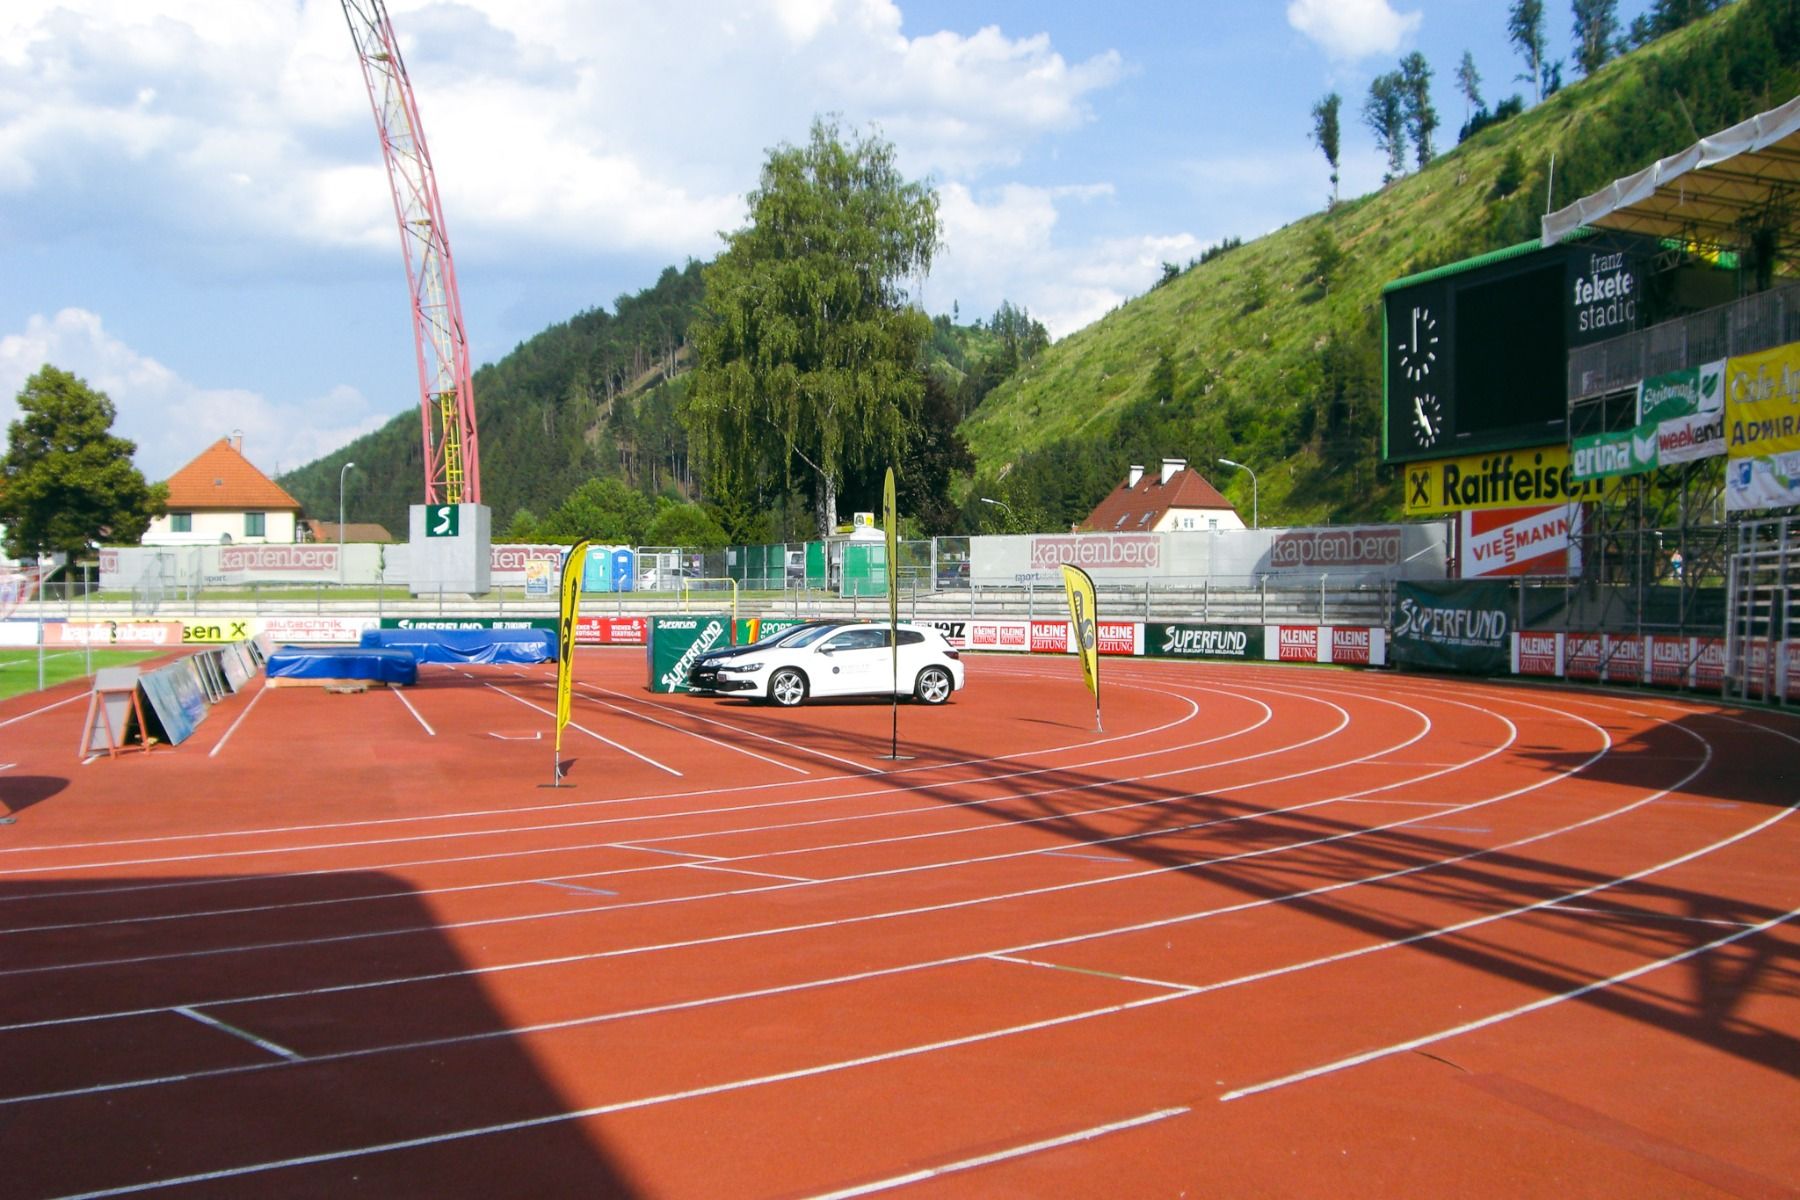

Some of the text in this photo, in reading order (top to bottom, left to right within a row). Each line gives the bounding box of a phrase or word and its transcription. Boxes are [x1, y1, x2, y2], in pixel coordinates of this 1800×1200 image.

[1591, 252, 1623, 274] franz
[1575, 270, 1634, 305] fekete
[1660, 415, 1725, 451] weekend
[1574, 439, 1631, 477] erima
[1272, 529, 1401, 567] kapfenberg
[1473, 517, 1570, 563] VIESSMANN
[219, 548, 338, 571] kapfenberg
[1032, 536, 1160, 568] kapfenberg
[266, 619, 342, 629] alutechnik
[1394, 598, 1507, 640] SUPERFUND
[974, 627, 996, 635] KLEINE
[1001, 627, 1024, 635] KLEINE
[1032, 625, 1067, 637] KLEINE
[1098, 625, 1133, 639] KLEINE
[1162, 625, 1247, 652] SUPERFUND
[1281, 630, 1316, 644] KLEINE
[1334, 631, 1369, 646] KLEINE
[1032, 639, 1067, 650] ZEITUNG
[1098, 641, 1133, 651] ZEITUNG
[1281, 646, 1317, 658] ZEITUNG
[1521, 637, 1554, 654] KLEINE
[1698, 644, 1727, 662] KLEIN
[661, 620, 723, 694] SUPERFUND
[1333, 649, 1369, 660] ZEITUNG
